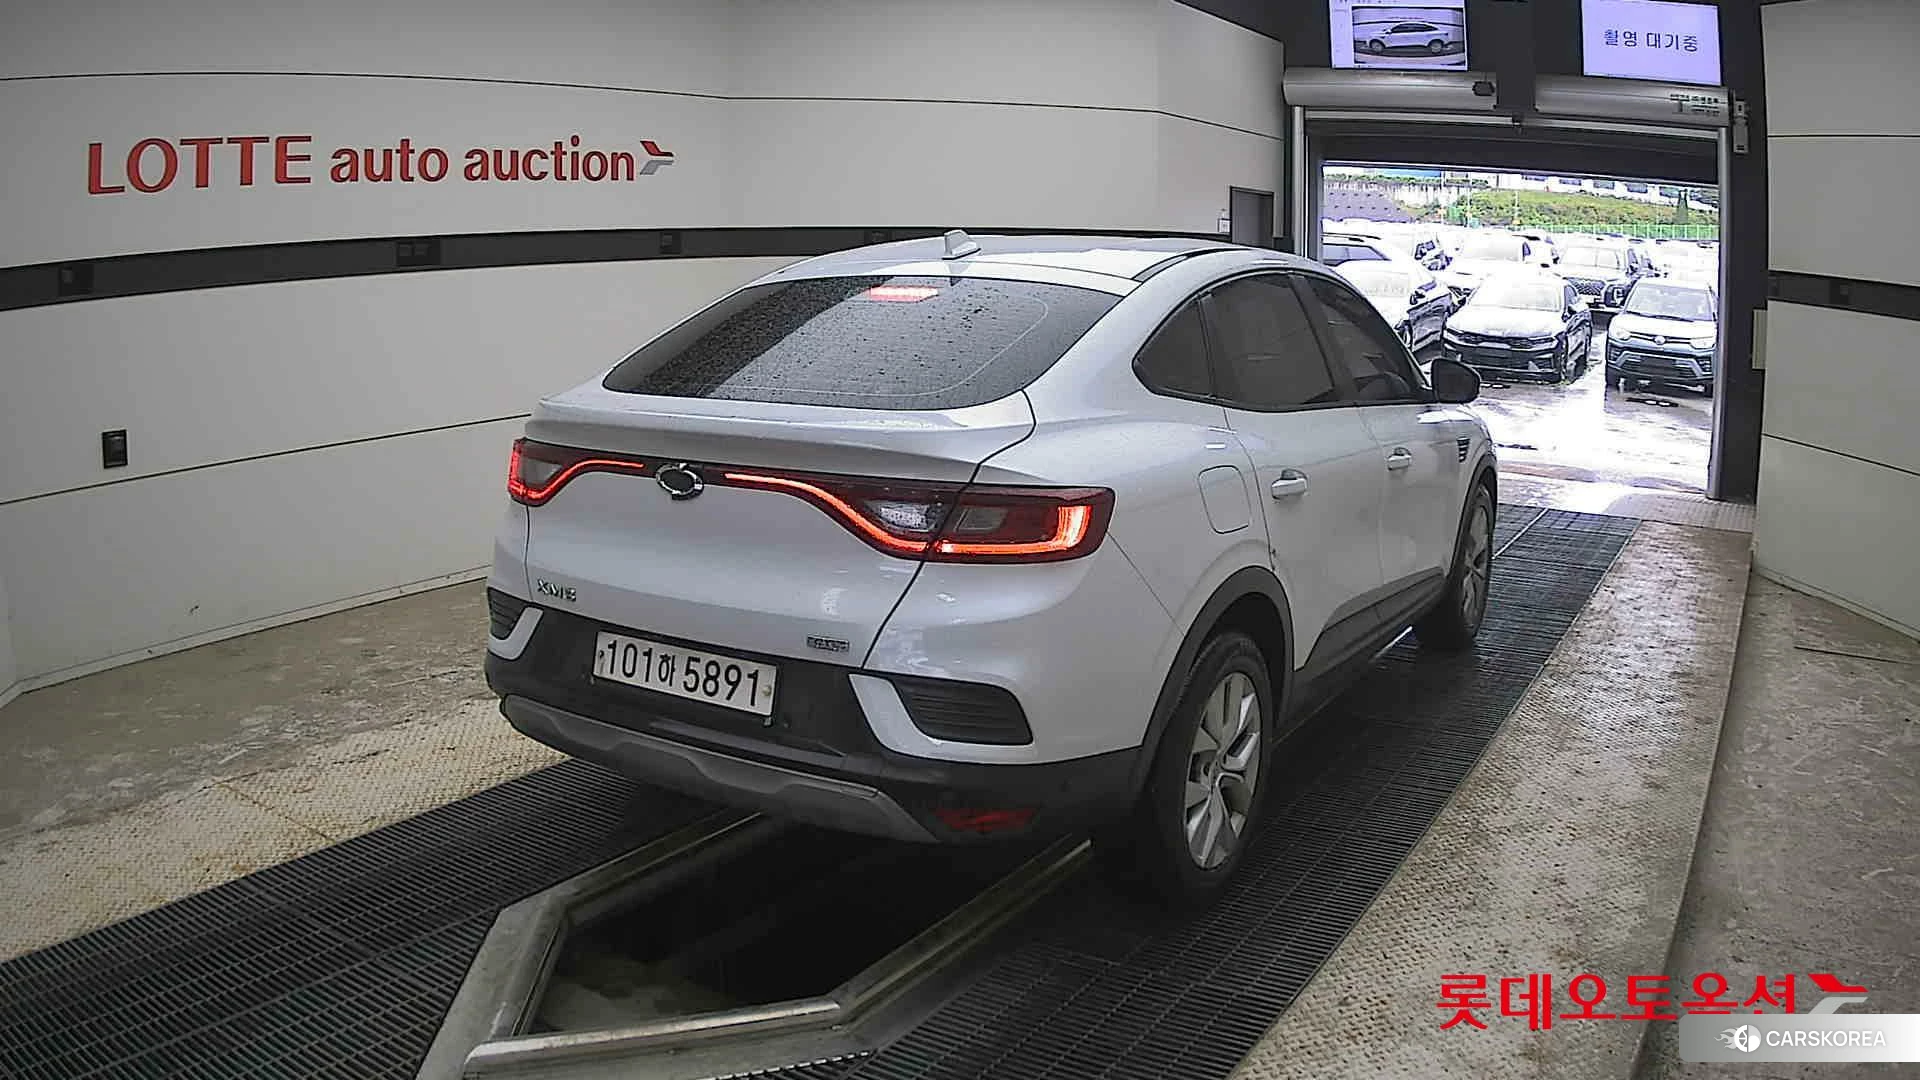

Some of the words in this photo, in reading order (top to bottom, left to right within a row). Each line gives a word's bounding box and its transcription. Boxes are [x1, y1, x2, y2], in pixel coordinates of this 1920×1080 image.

[1646, 31, 1698, 52] 대기중
[87, 135, 313, 195] LOTTE
[329, 138, 449, 183] auto
[463, 134, 635, 182] auction
[683, 656, 759, 707] 5891
